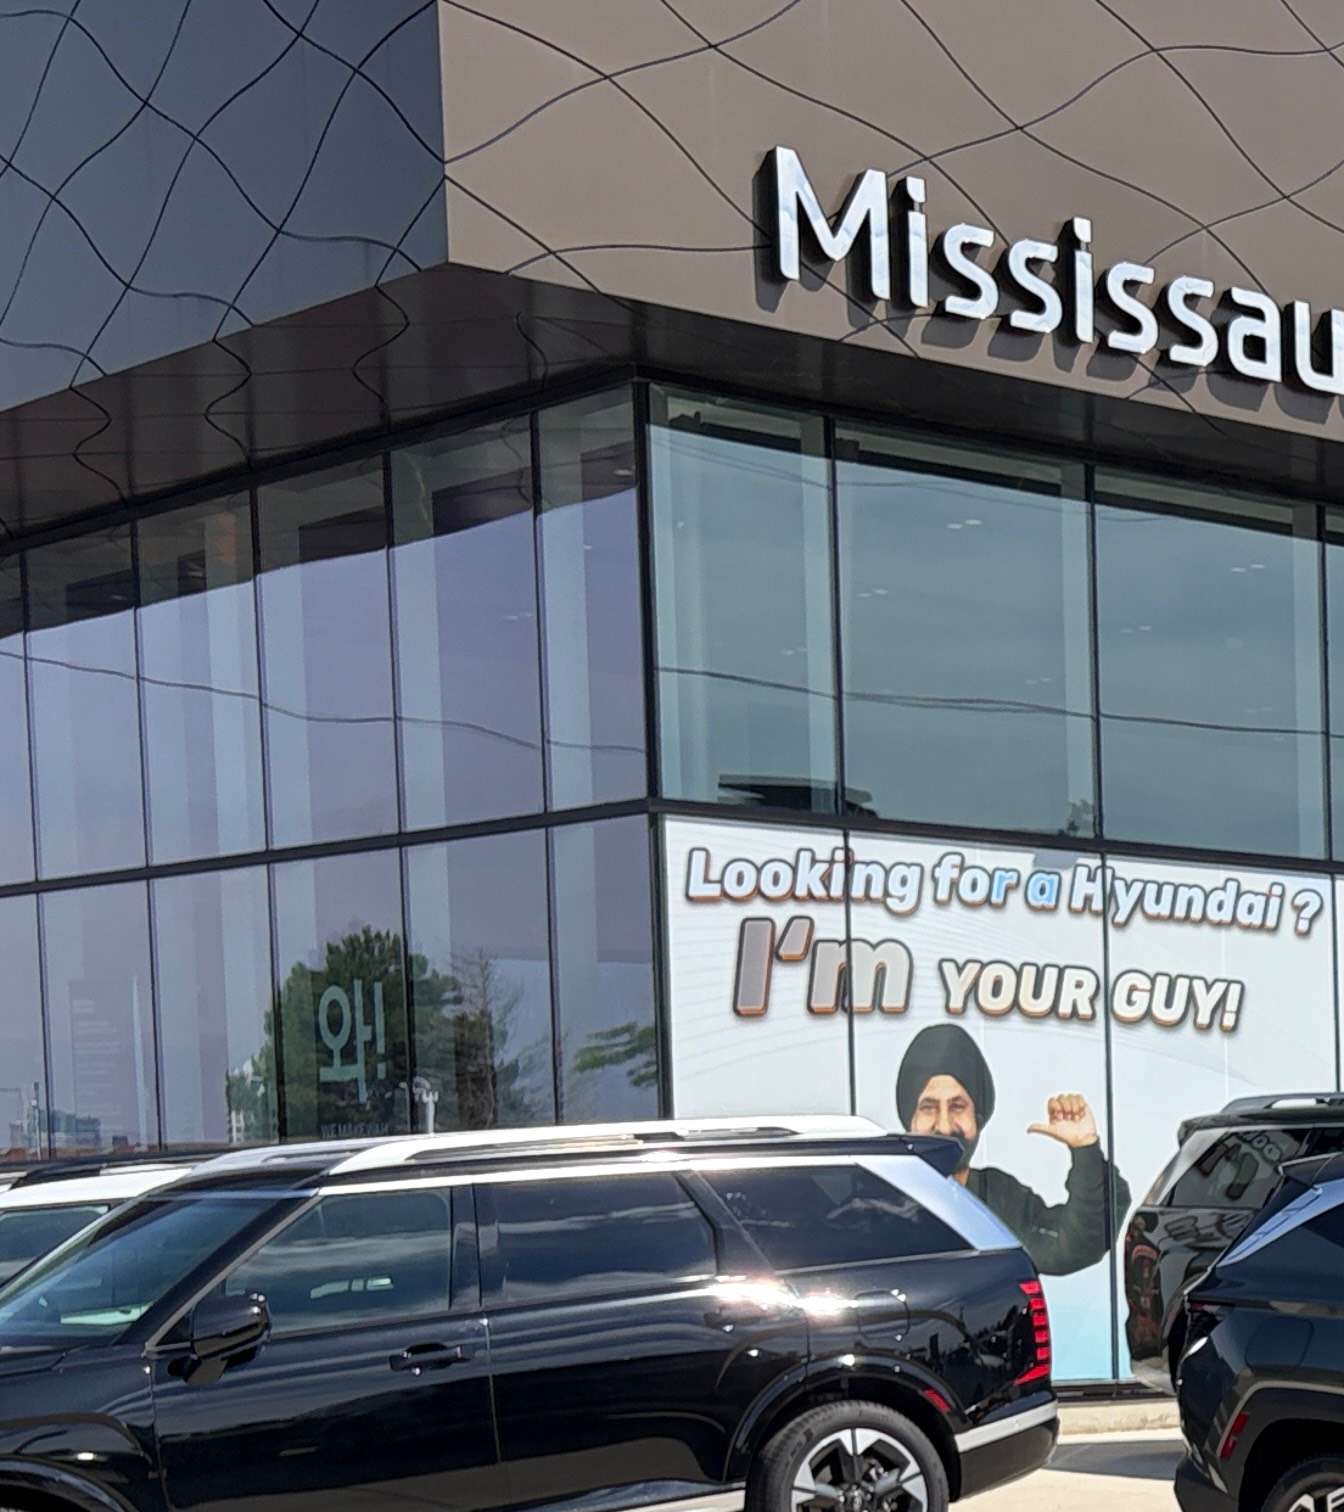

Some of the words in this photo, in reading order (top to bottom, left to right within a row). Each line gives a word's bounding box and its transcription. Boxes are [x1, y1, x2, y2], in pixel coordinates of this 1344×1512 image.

[686, 847, 922, 913] Looking
[932, 851, 1019, 908] for
[1025, 866, 1060, 910] a
[1069, 863, 1284, 932] Hyundai
[733, 916, 914, 1017] I'm
[940, 958, 1100, 1021] YOUR
[1113, 970, 1246, 1033] GUY!
